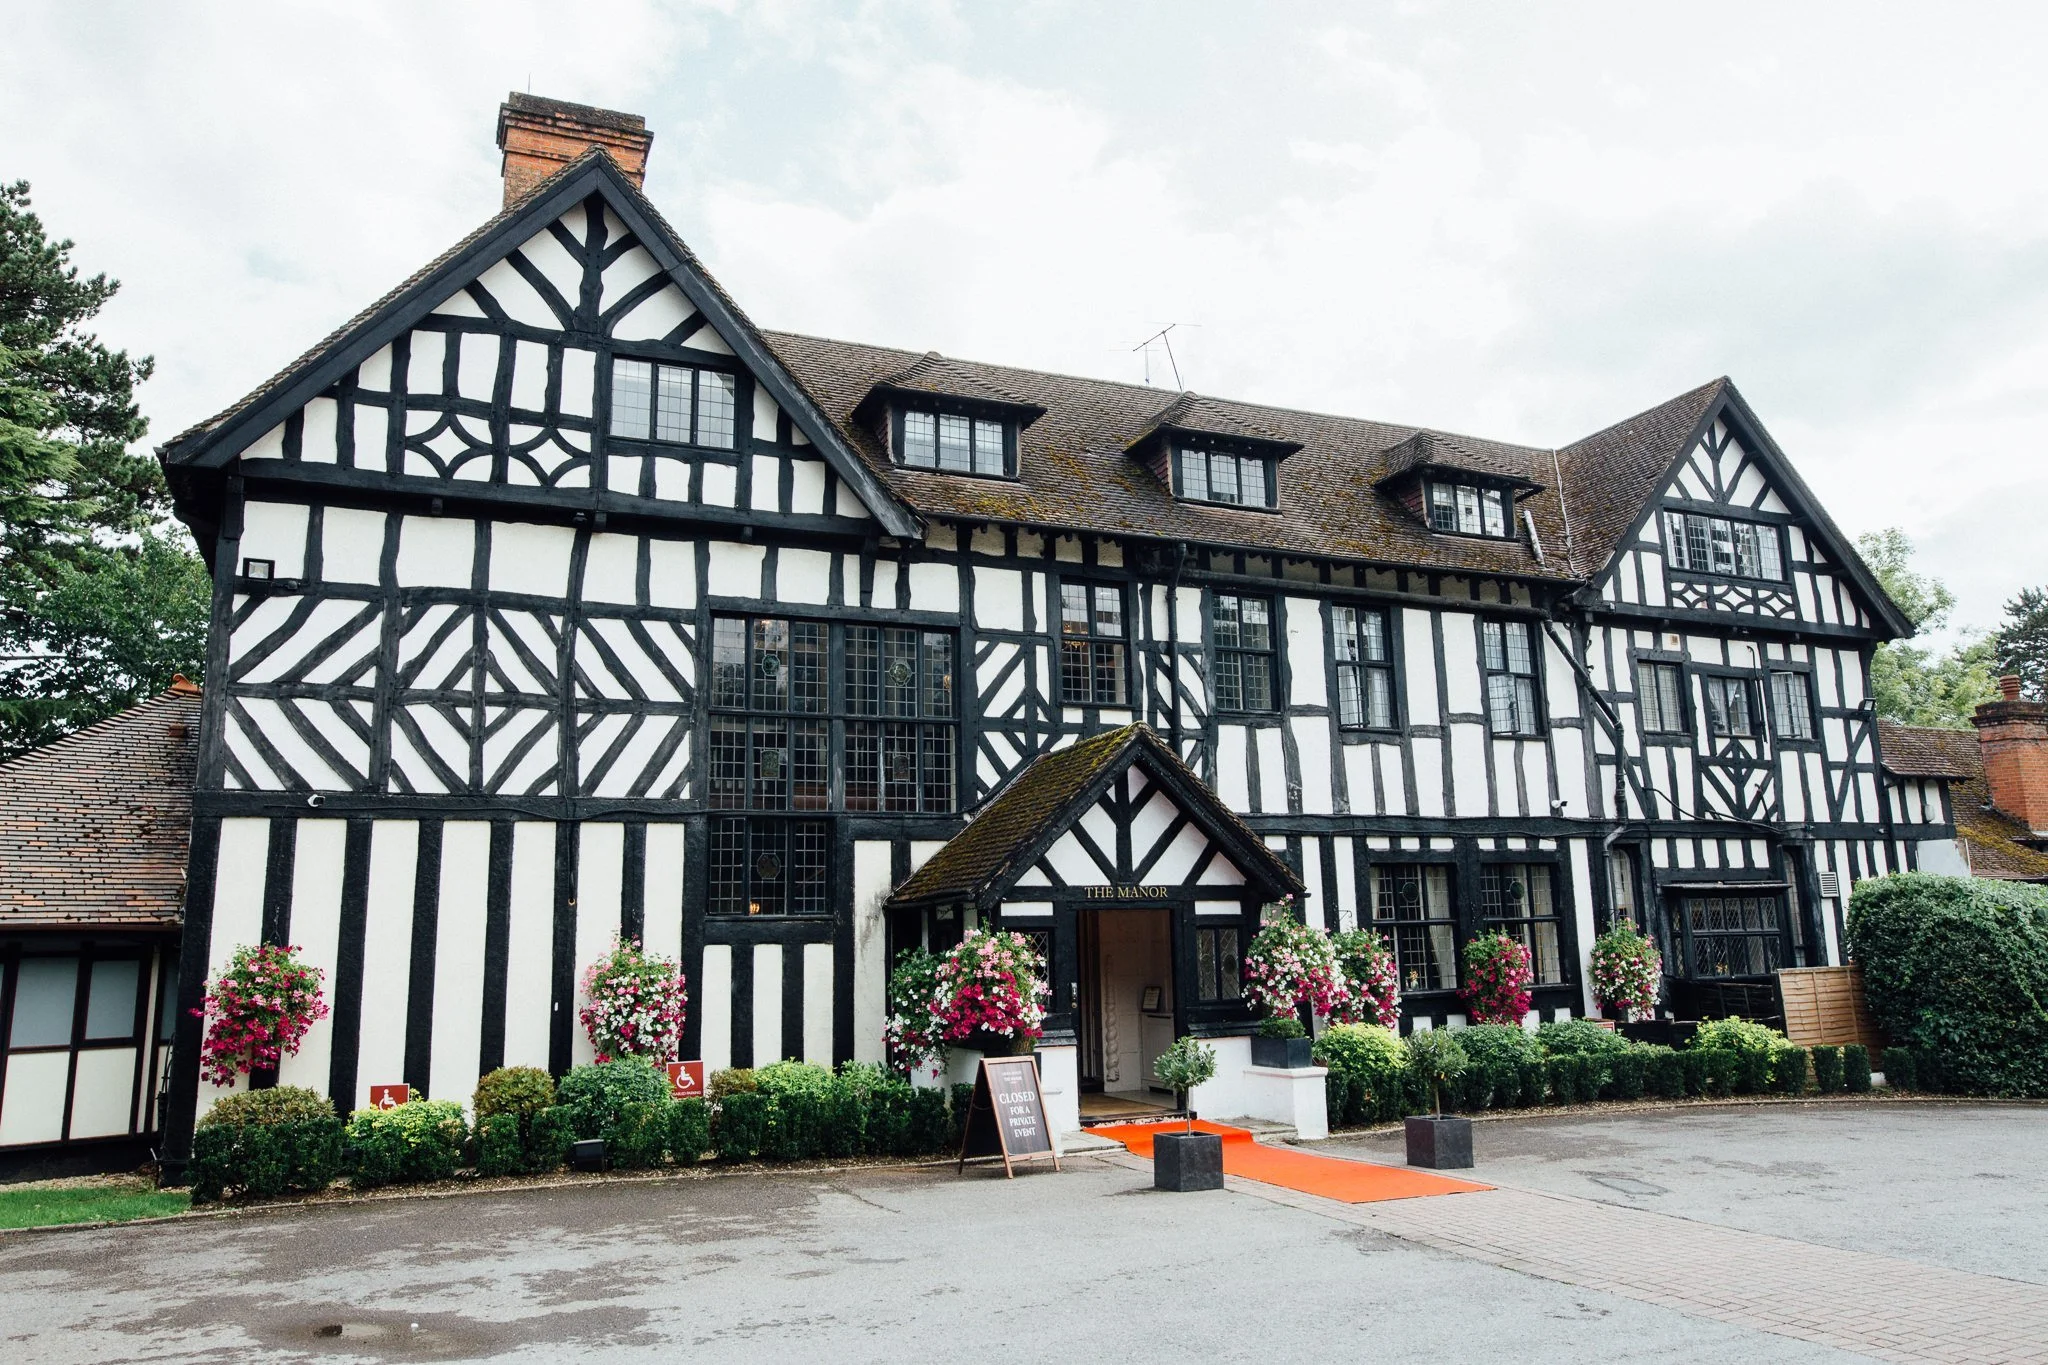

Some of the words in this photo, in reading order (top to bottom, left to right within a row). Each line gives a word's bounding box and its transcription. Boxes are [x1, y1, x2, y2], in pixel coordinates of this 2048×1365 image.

[1084, 886, 1114, 898] THE
[1118, 886, 1168, 898] MANOR
[999, 1092, 1035, 1104] CLOSED
[1010, 1106, 1025, 1115] FOR
[1025, 1105, 1031, 1114] A
[1009, 1117, 1036, 1126] PRIVATE
[1014, 1128, 1036, 1137] EVENT
